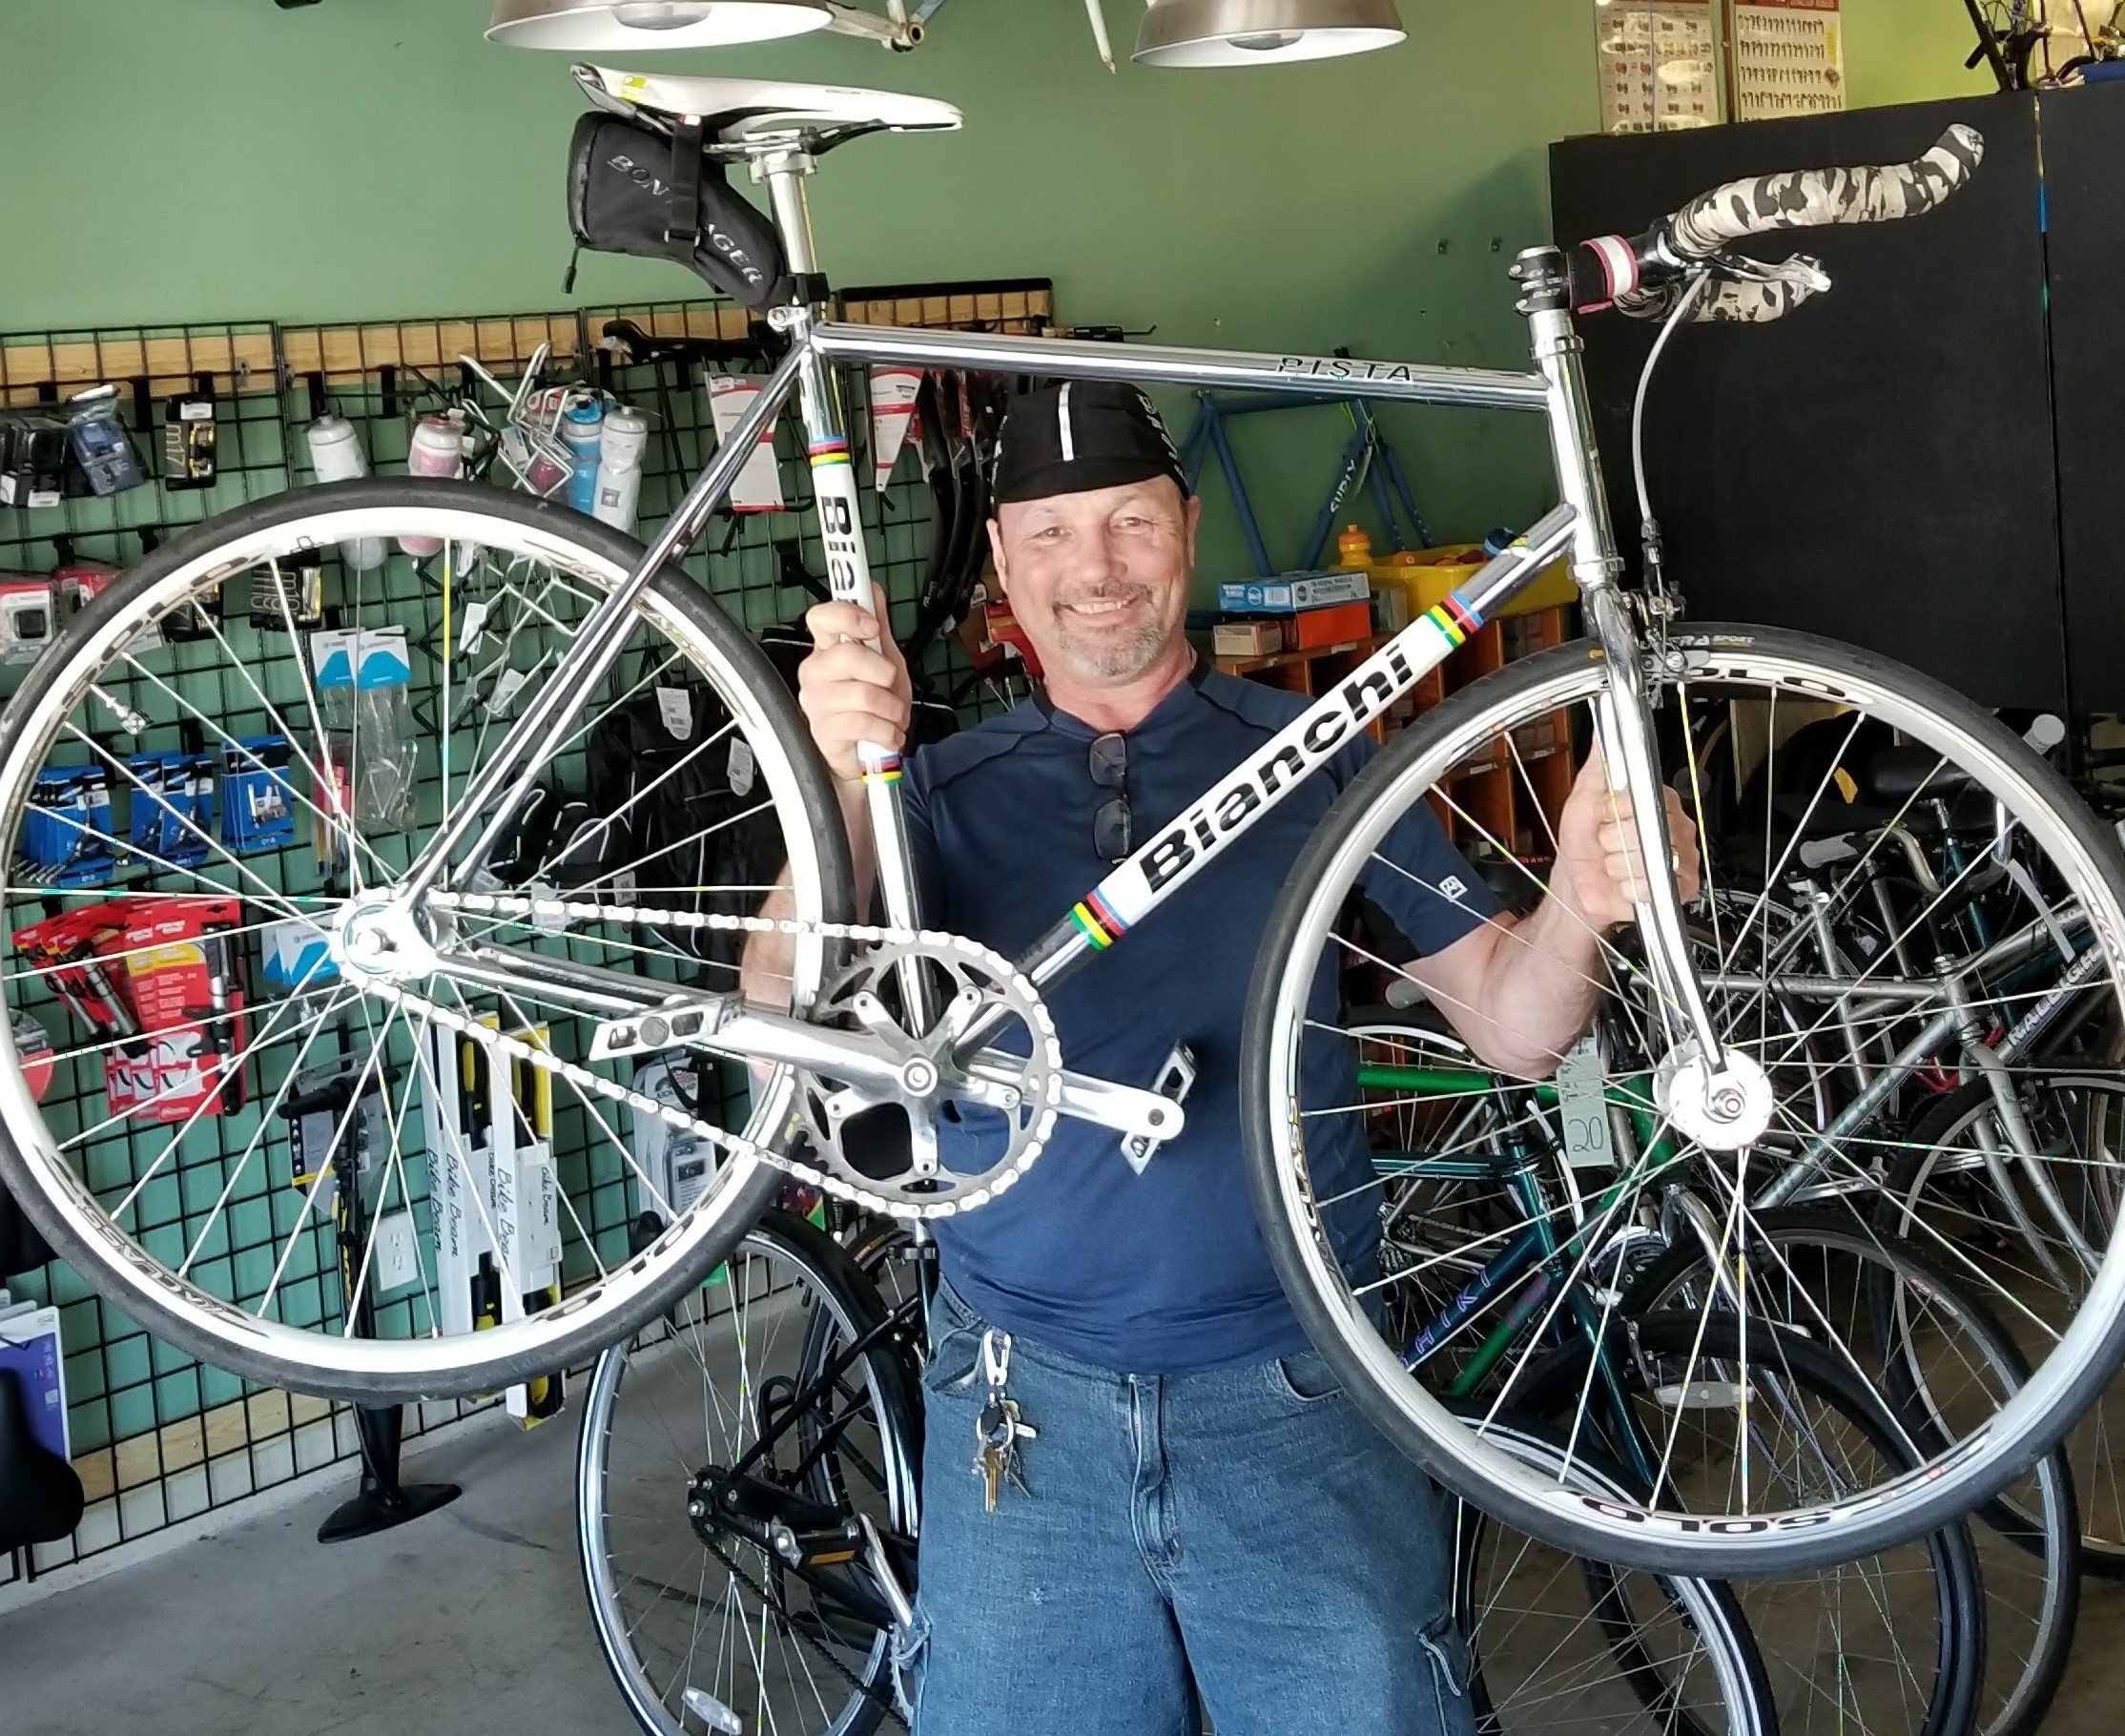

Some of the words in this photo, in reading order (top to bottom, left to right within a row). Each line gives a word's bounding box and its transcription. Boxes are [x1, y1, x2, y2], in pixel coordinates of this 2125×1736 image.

[1276, 357, 1413, 382] PISTA
[820, 496, 858, 605] Bia
[1139, 643, 1414, 895] Bianchi
[1568, 1115, 1604, 1153] 20
[427, 1149, 442, 1193] Bike
[446, 1152, 461, 1198] Bike
[497, 1168, 514, 1213] Bike
[431, 1196, 444, 1252] Beam
[449, 1202, 463, 1258] Beam
[1580, 1496, 1832, 1534] SOLO
